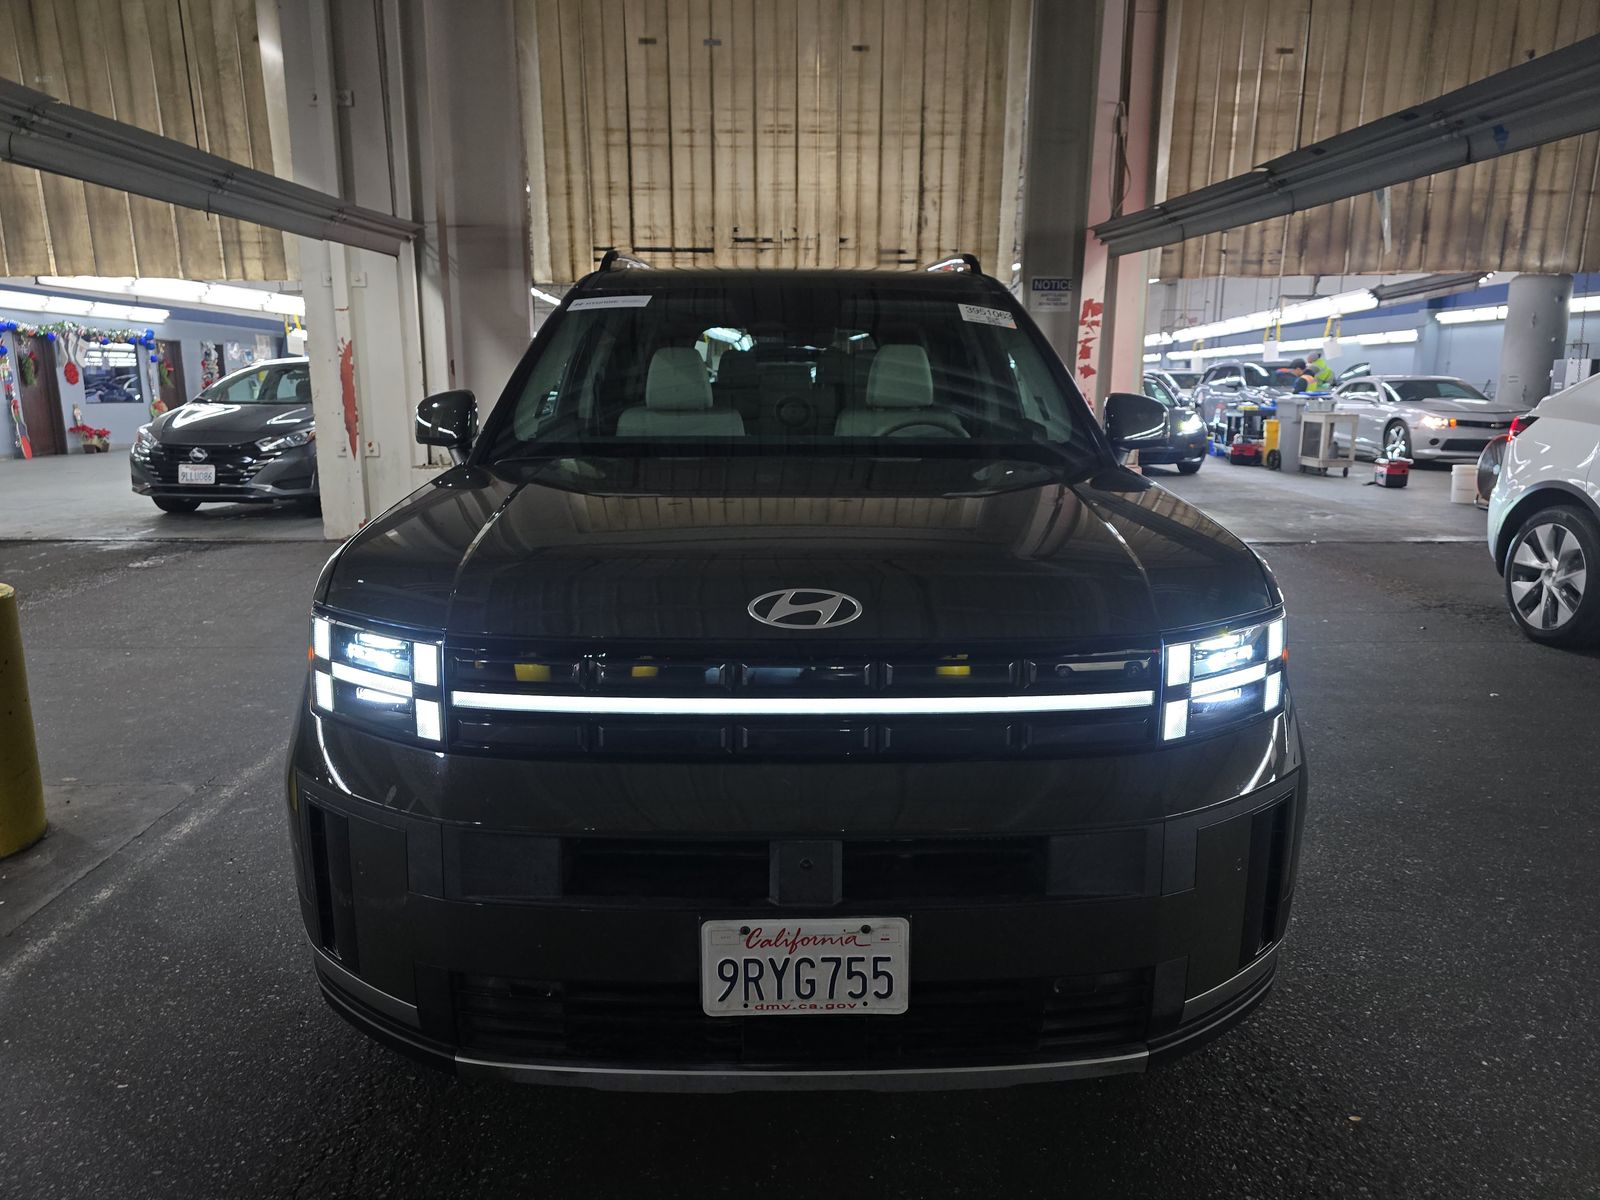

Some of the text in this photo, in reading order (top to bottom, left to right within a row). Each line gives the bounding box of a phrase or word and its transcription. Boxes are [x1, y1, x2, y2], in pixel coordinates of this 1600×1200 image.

[1034, 279, 1072, 290] NOTICE
[745, 927, 871, 955] California
[717, 956, 894, 1002] 9RYG755
[754, 1002, 857, 1010] dmv.ca.gov
